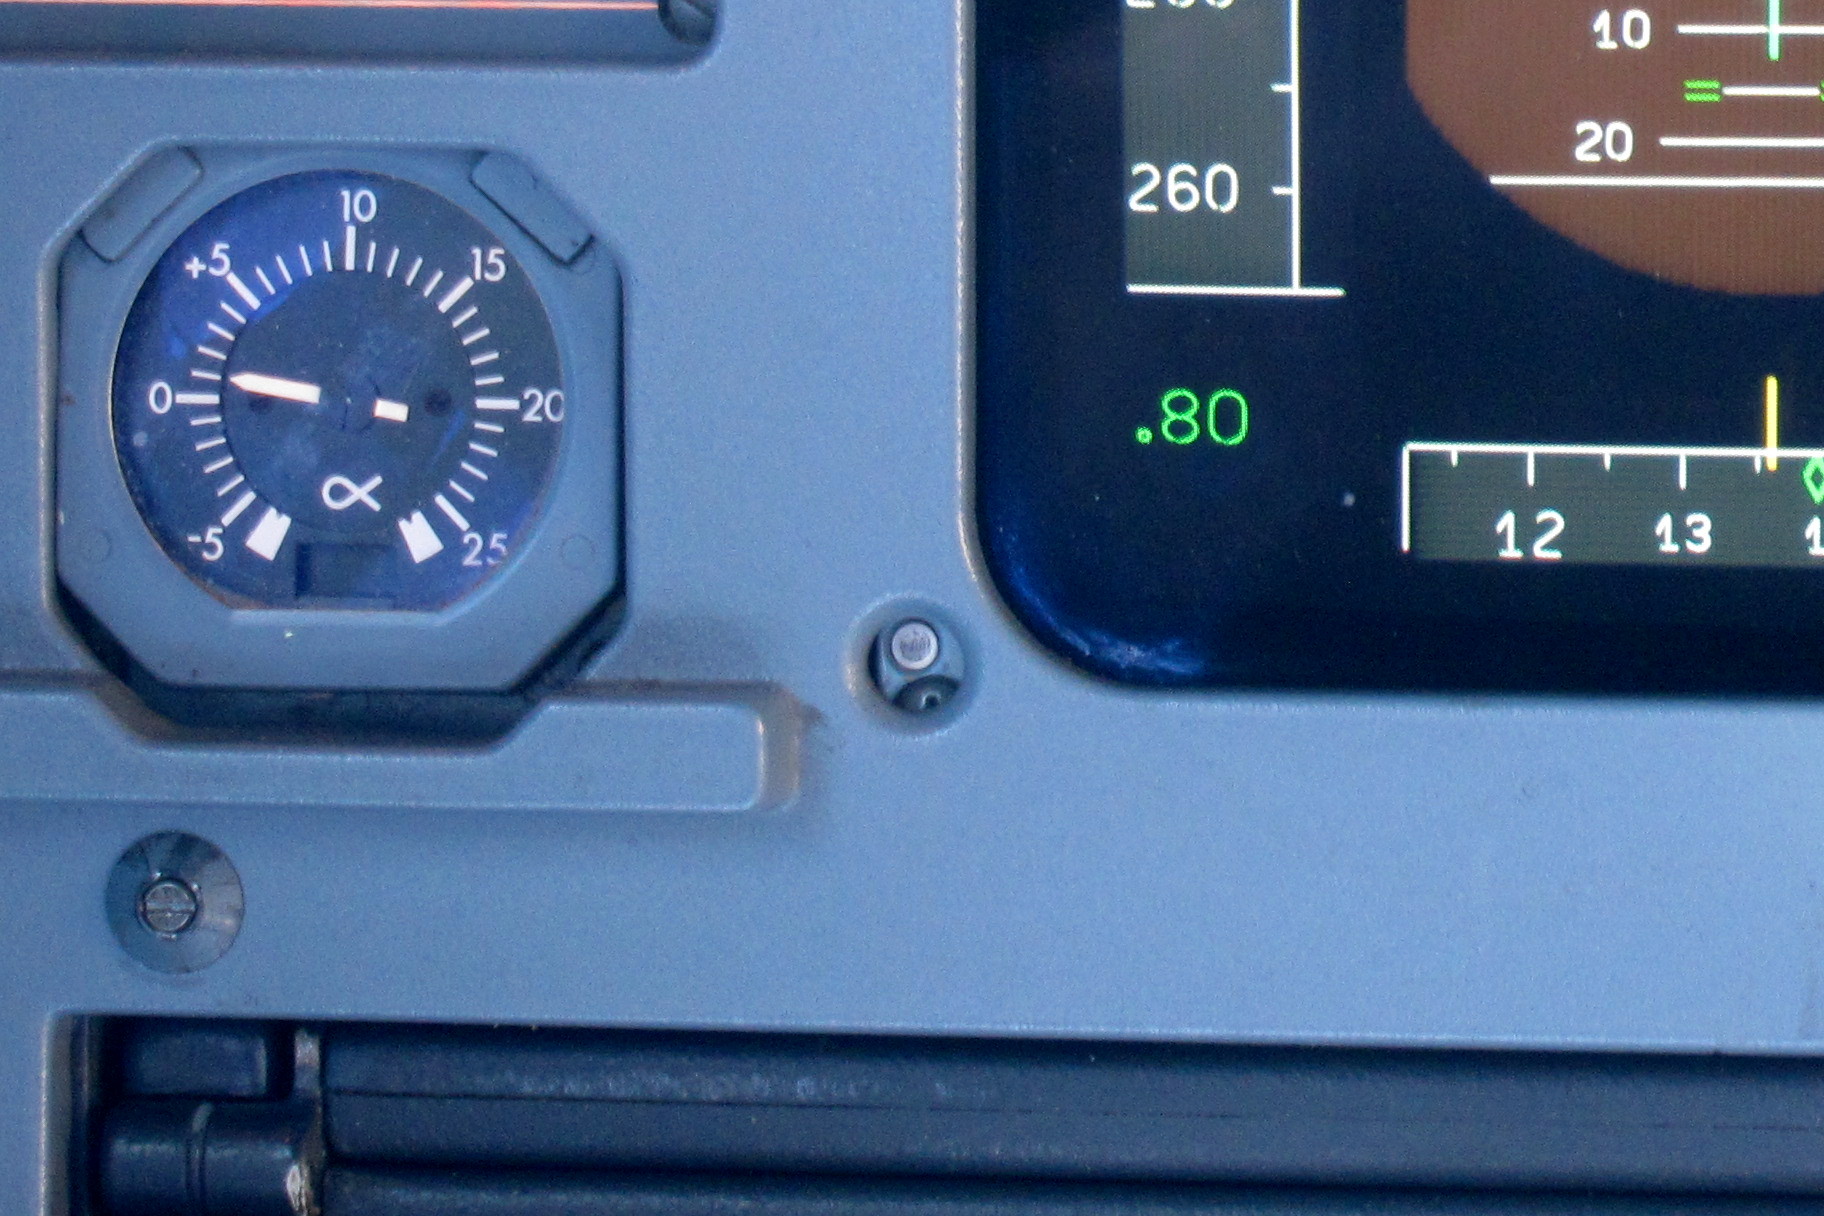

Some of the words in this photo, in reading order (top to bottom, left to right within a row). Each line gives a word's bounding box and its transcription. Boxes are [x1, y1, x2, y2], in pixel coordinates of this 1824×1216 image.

[1592, 8, 1651, 50] 10
[1574, 120, 1634, 163] 20
[1127, 162, 1240, 214] 260
[341, 190, 377, 223] 10
[186, 243, 231, 278] +5
[472, 247, 507, 281] 15
[148, 381, 173, 415] 0
[521, 388, 565, 423] 20
[1135, 388, 1249, 446] .80
[188, 529, 224, 561] -5
[461, 531, 508, 567] 25
[1495, 510, 1566, 561] 12
[1654, 513, 1713, 554] 13
